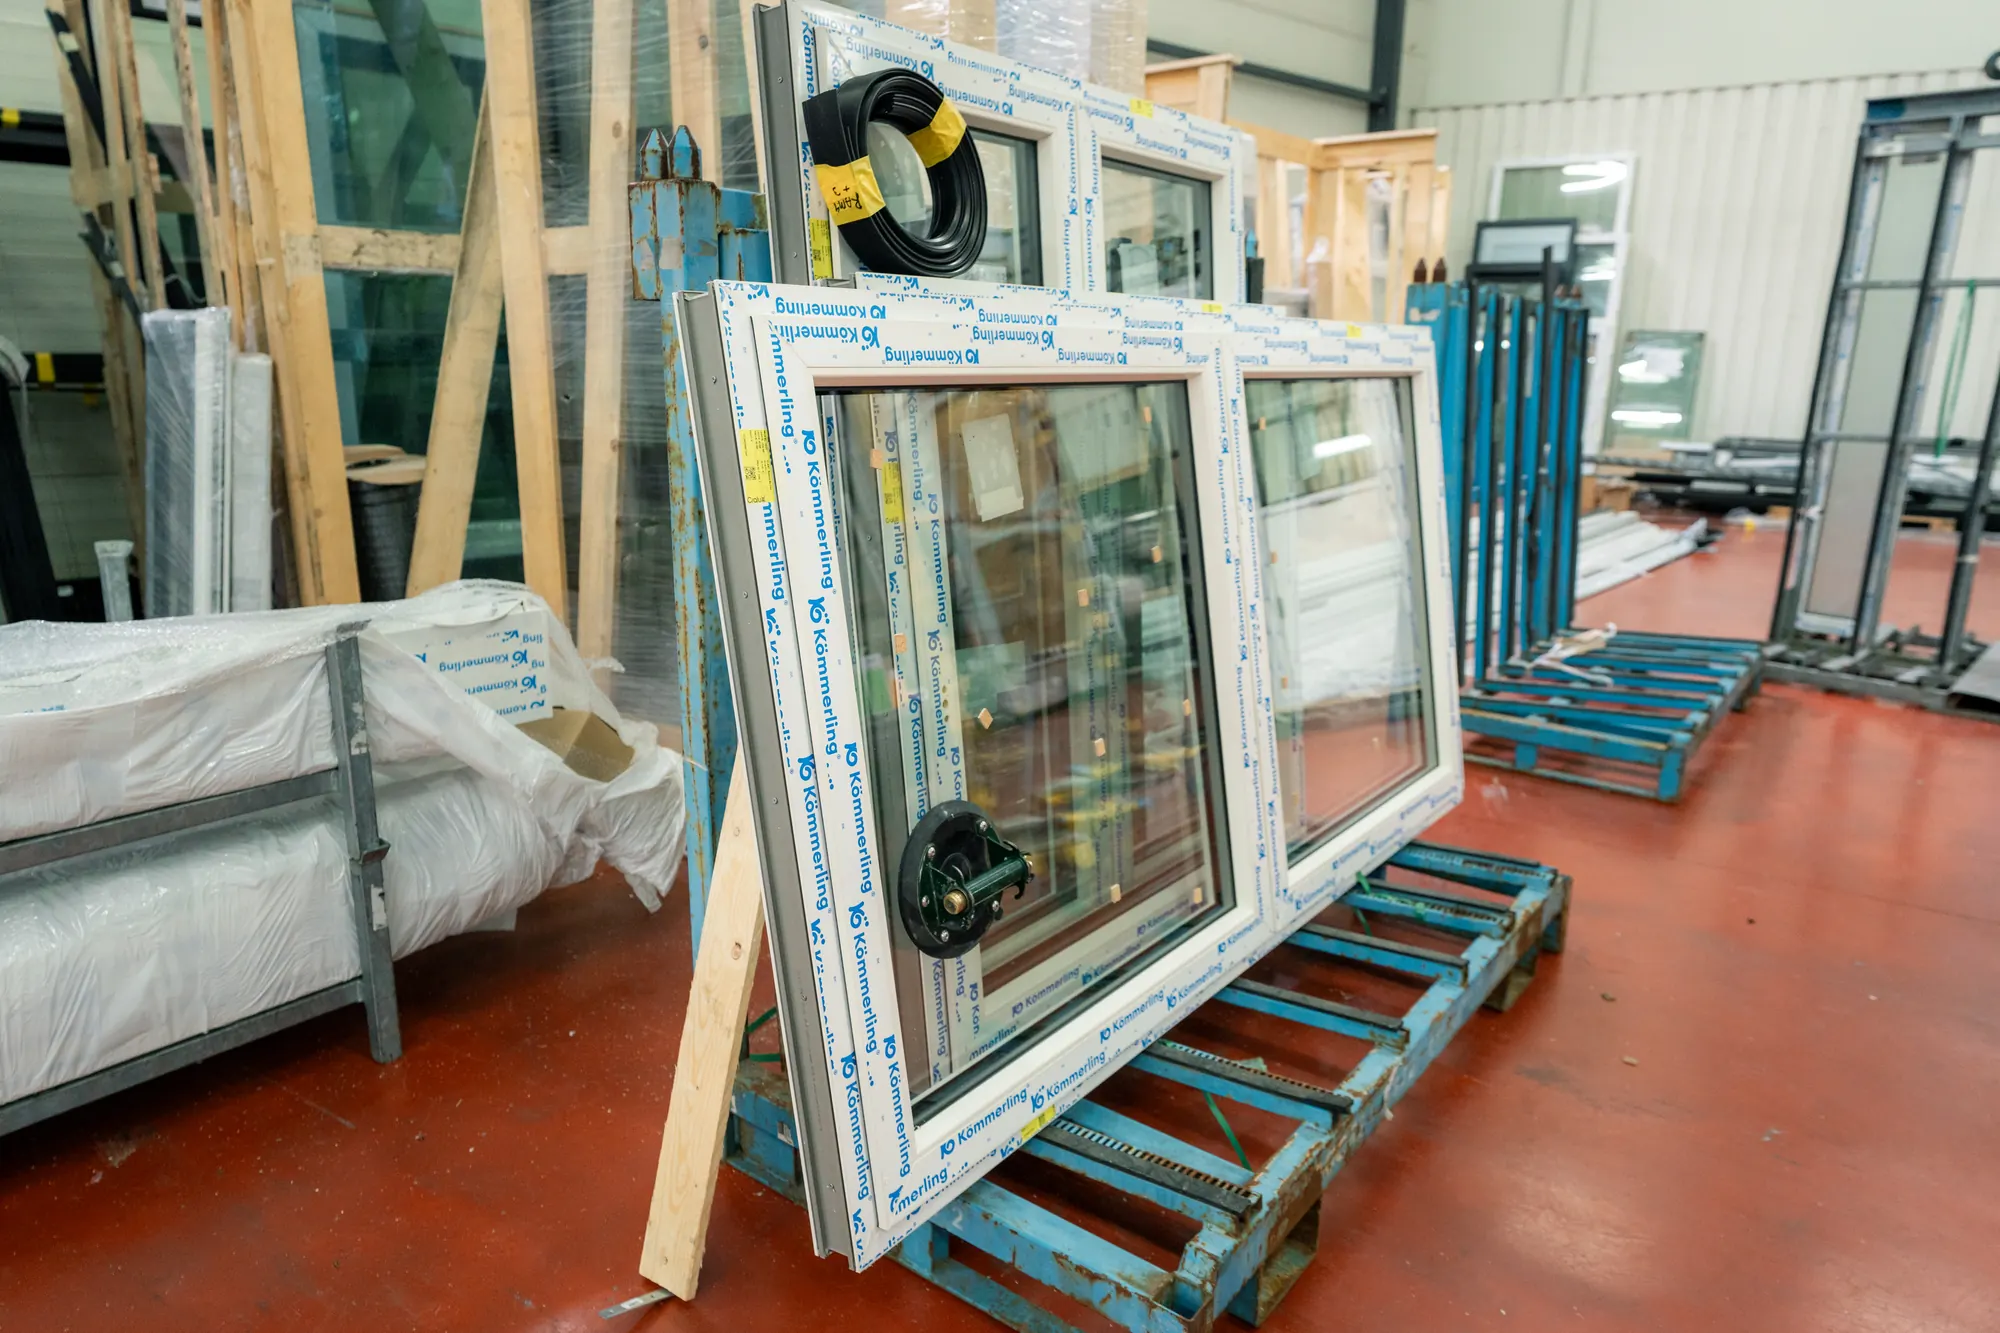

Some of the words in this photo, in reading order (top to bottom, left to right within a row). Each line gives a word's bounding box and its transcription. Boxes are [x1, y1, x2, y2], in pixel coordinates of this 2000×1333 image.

[885, 346, 963, 365] Kömmerling
[972, 326, 1039, 345] Kömmerling
[1057, 348, 1115, 365] Kömmerling
[1122, 333, 1172, 348] Kömmerling
[763, 501, 785, 601] mmerling
[807, 461, 834, 590] Kömmerling
[931, 519, 947, 623] Kömmerling
[439, 653, 509, 672] Kömmerling
[813, 628, 839, 756] Kömmerling
[930, 655, 947, 758] Kömmerling
[911, 718, 928, 821] Kömmerling
[803, 785, 829, 911] Kömmerling
[849, 771, 873, 894] Kömmerling
[853, 932, 878, 1054] Kömmerling
[932, 959, 947, 1057] Kömmerling
[1113, 989, 1164, 1033] Kömmerling
[1178, 961, 1223, 1002] Kömmerling
[888, 1061, 911, 1178] Kömmerling
[958, 1088, 1027, 1146] Kömmerling
[1046, 1051, 1106, 1101] Kömmerling
[846, 1081, 870, 1201] Kömmerling
